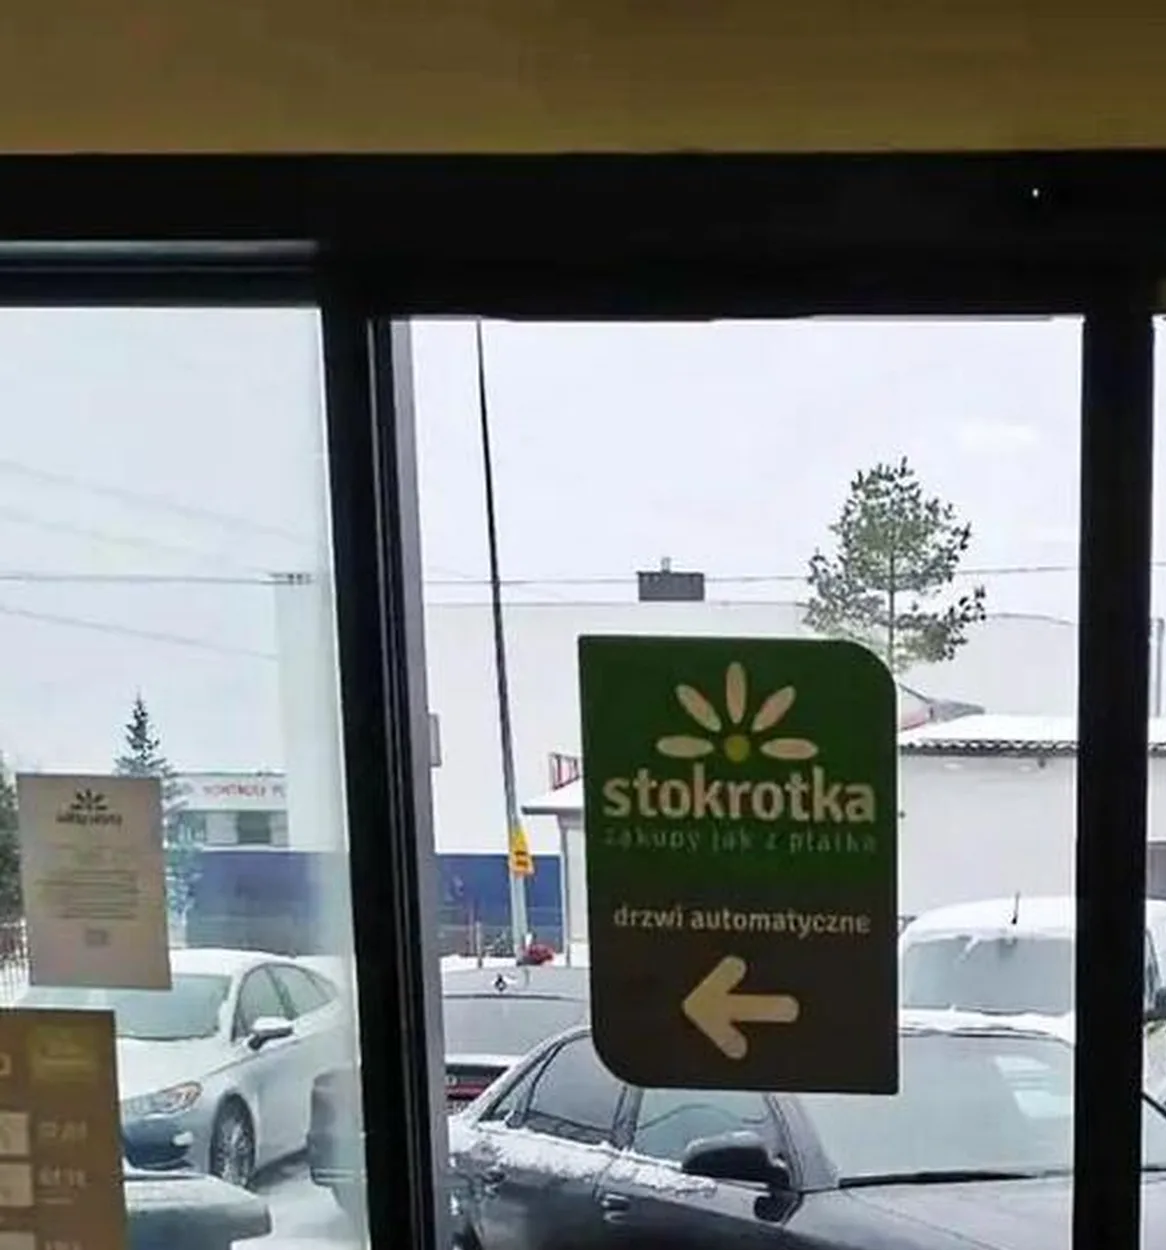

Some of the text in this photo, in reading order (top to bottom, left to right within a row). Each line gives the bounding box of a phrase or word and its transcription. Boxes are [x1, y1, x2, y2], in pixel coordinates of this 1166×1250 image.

[602, 762, 877, 823] stokrotka
[603, 827, 701, 854] zakupy
[711, 826, 753, 853] jak
[613, 901, 872, 940] drzwi automatyczne
